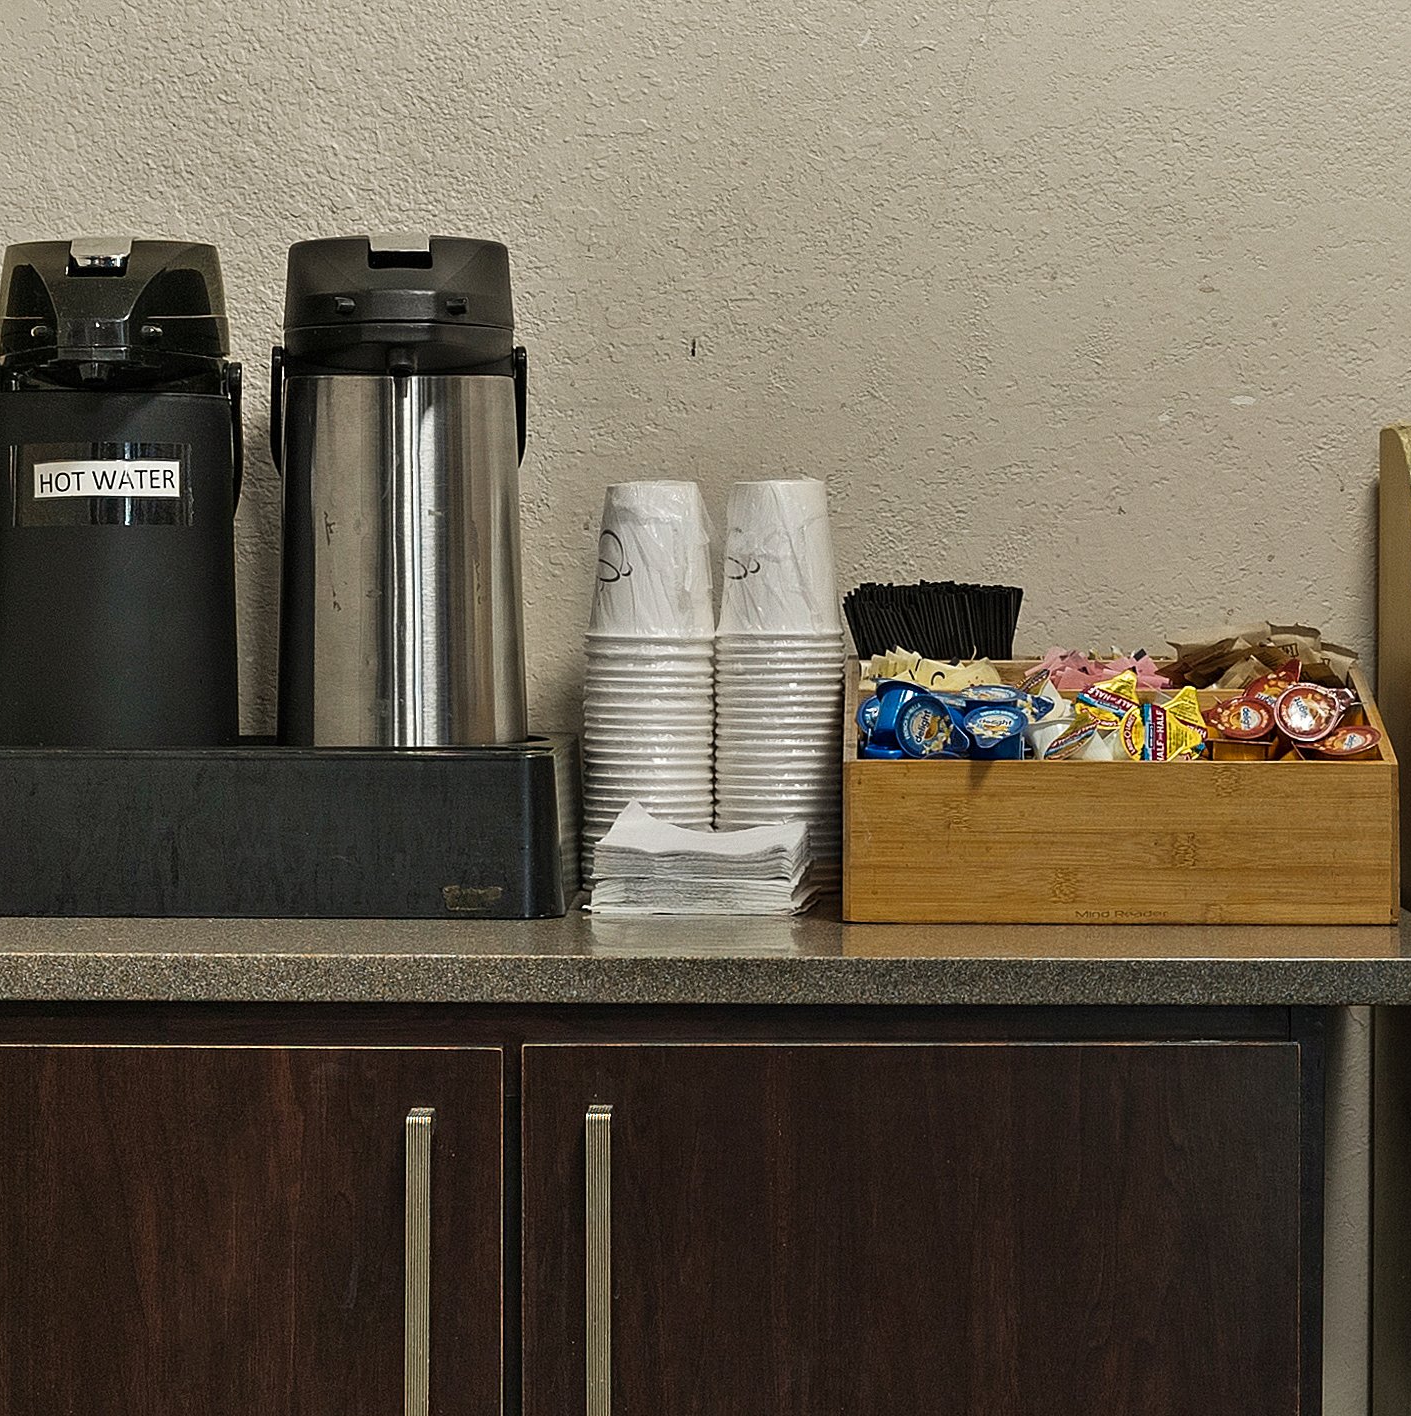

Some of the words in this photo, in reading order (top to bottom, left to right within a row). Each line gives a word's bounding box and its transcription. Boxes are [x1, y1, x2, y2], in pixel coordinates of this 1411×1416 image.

[40, 472, 85, 493] HOT
[92, 469, 175, 490] WATER
[916, 710, 932, 743] delight
[1156, 711, 1165, 732] HALF
